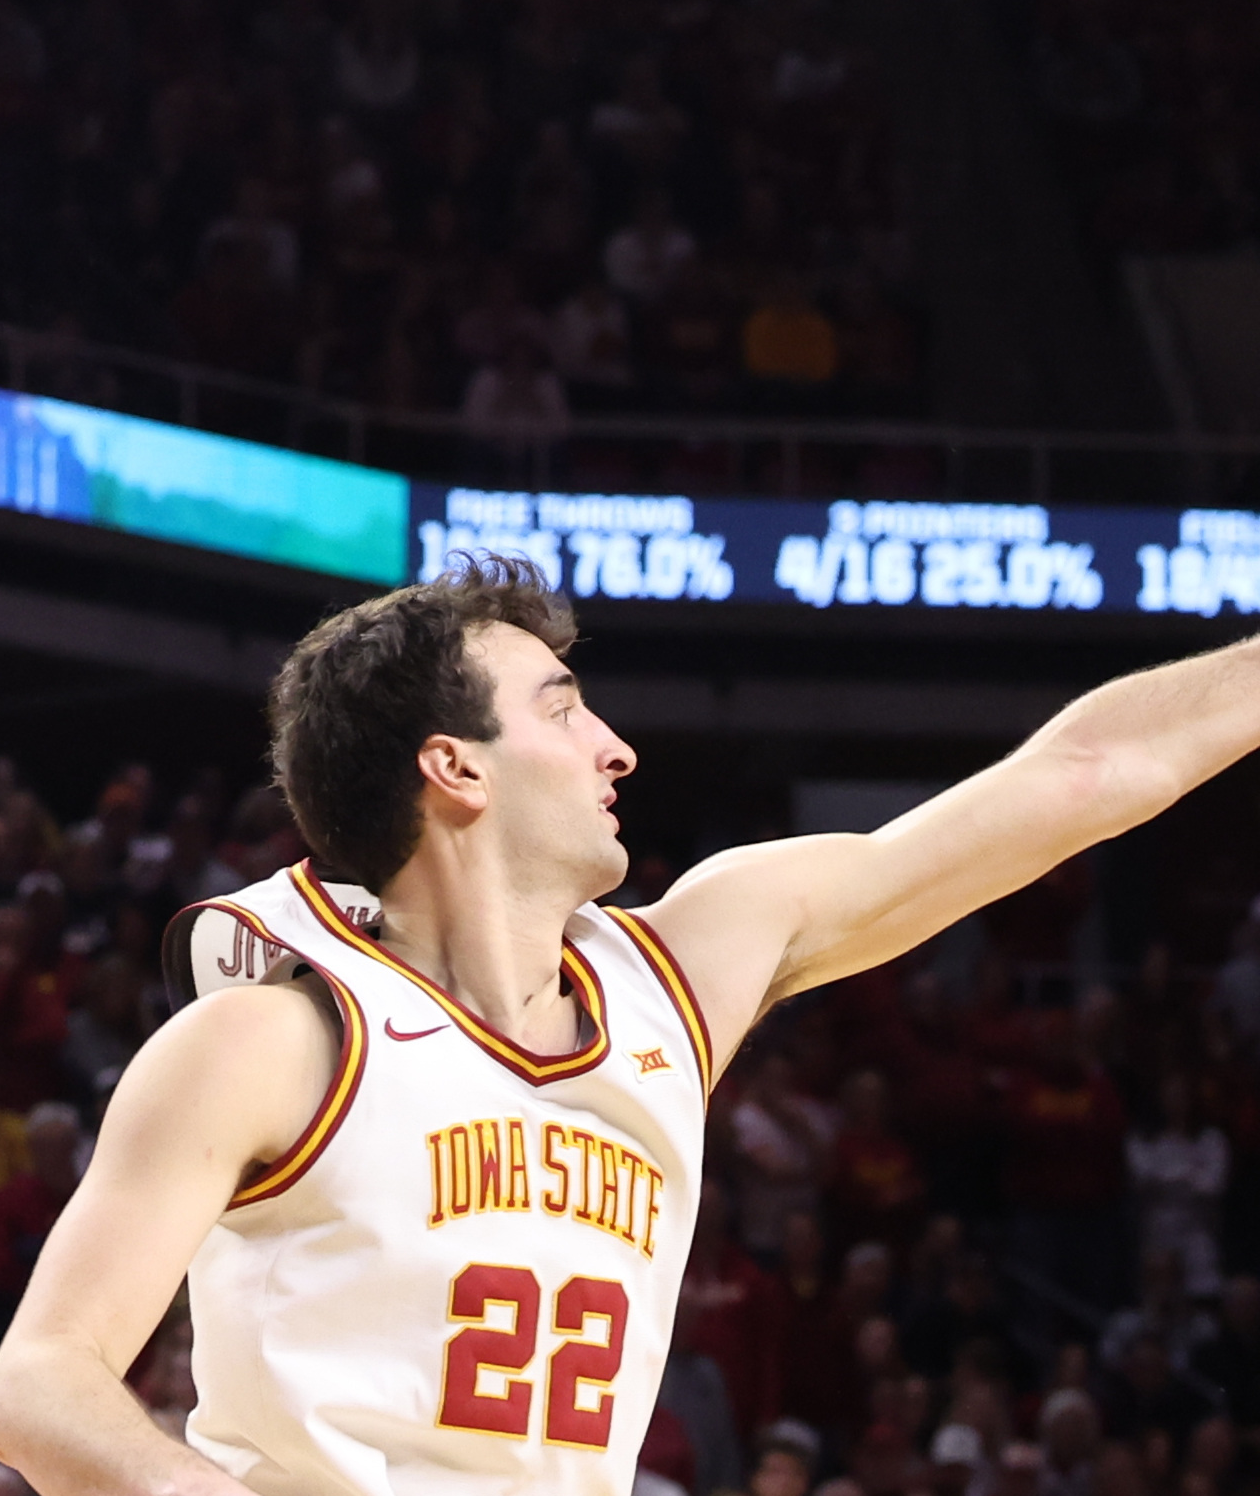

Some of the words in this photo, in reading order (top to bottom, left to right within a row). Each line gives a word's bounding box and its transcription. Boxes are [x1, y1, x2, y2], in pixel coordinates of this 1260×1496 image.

[569, 531, 733, 599] 76.0%
[776, 536, 914, 607] 4/16
[923, 540, 1102, 609] 25.0%
[425, 1116, 531, 1230] IOWA
[540, 1119, 666, 1263] STATE
[435, 1261, 630, 1453] 22
